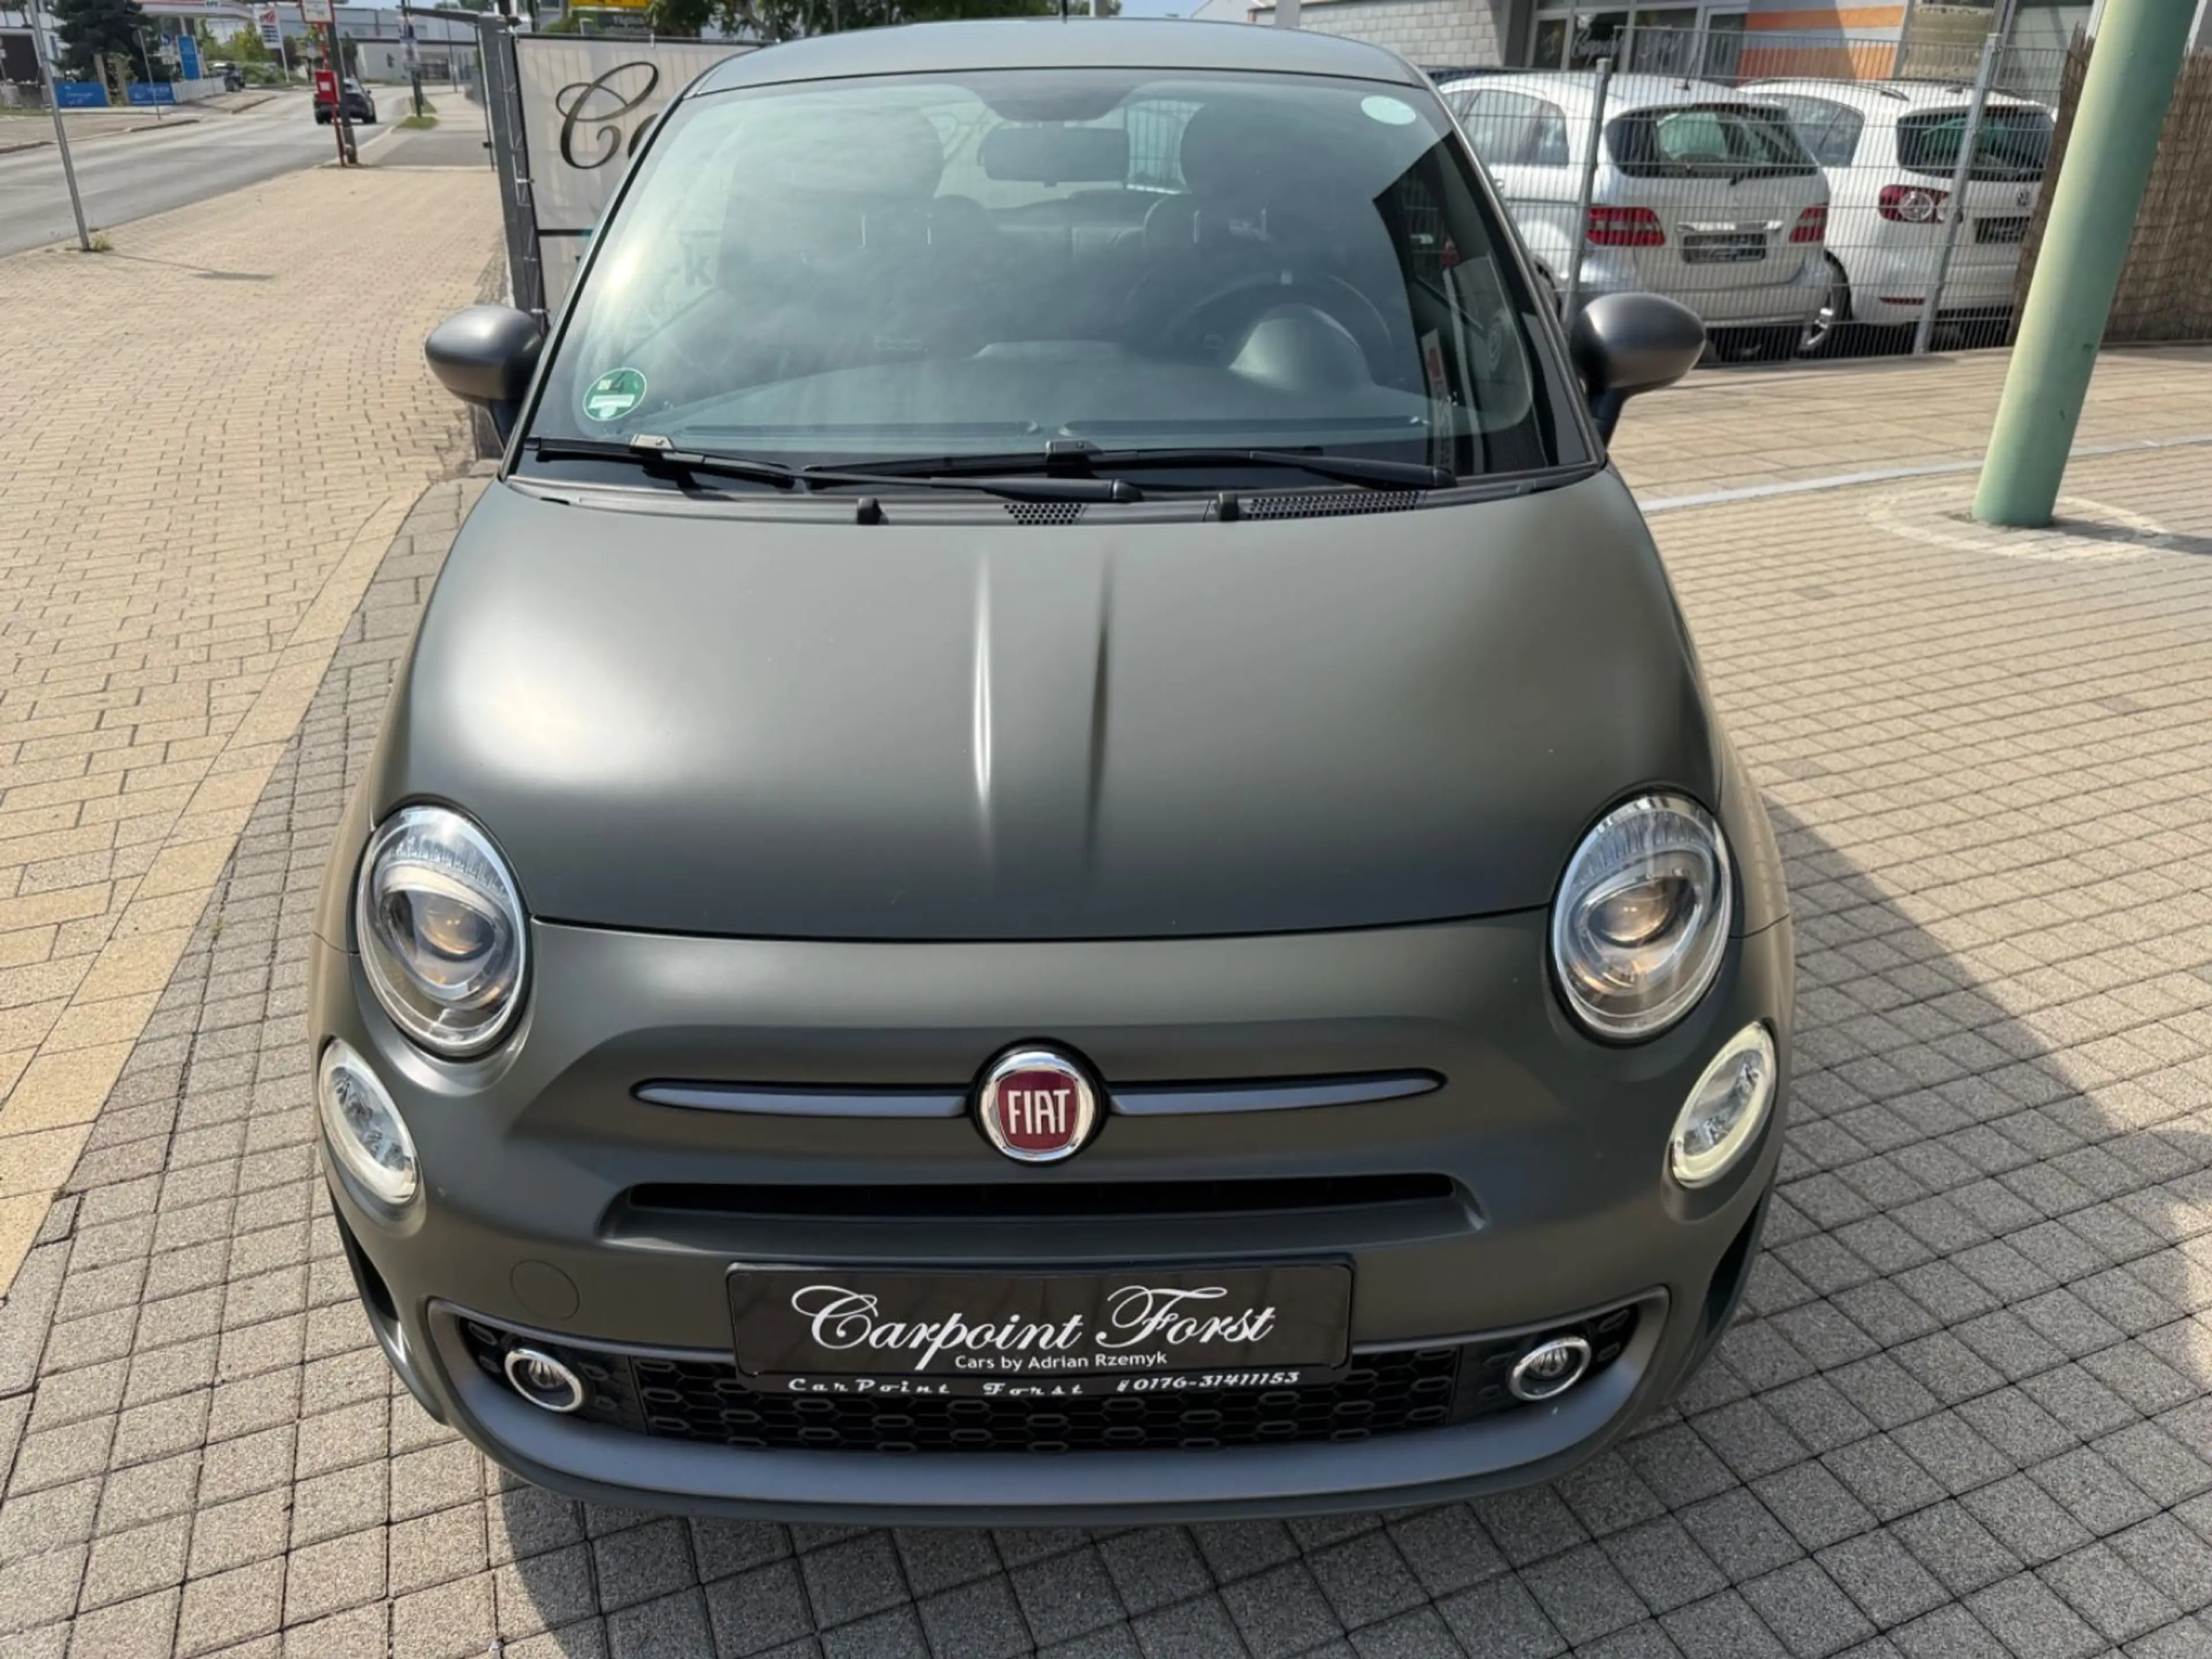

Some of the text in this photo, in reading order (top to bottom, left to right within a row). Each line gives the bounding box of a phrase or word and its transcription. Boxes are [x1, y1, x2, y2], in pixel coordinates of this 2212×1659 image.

[1007, 1089, 1070, 1134] FIAT
[791, 1285, 1276, 1370] Carpoint Forst
[955, 1351, 1168, 1372] Cars by Adrian Rzemyk
[788, 1371, 1300, 1396] CarPoint Forst 0176-31411153
